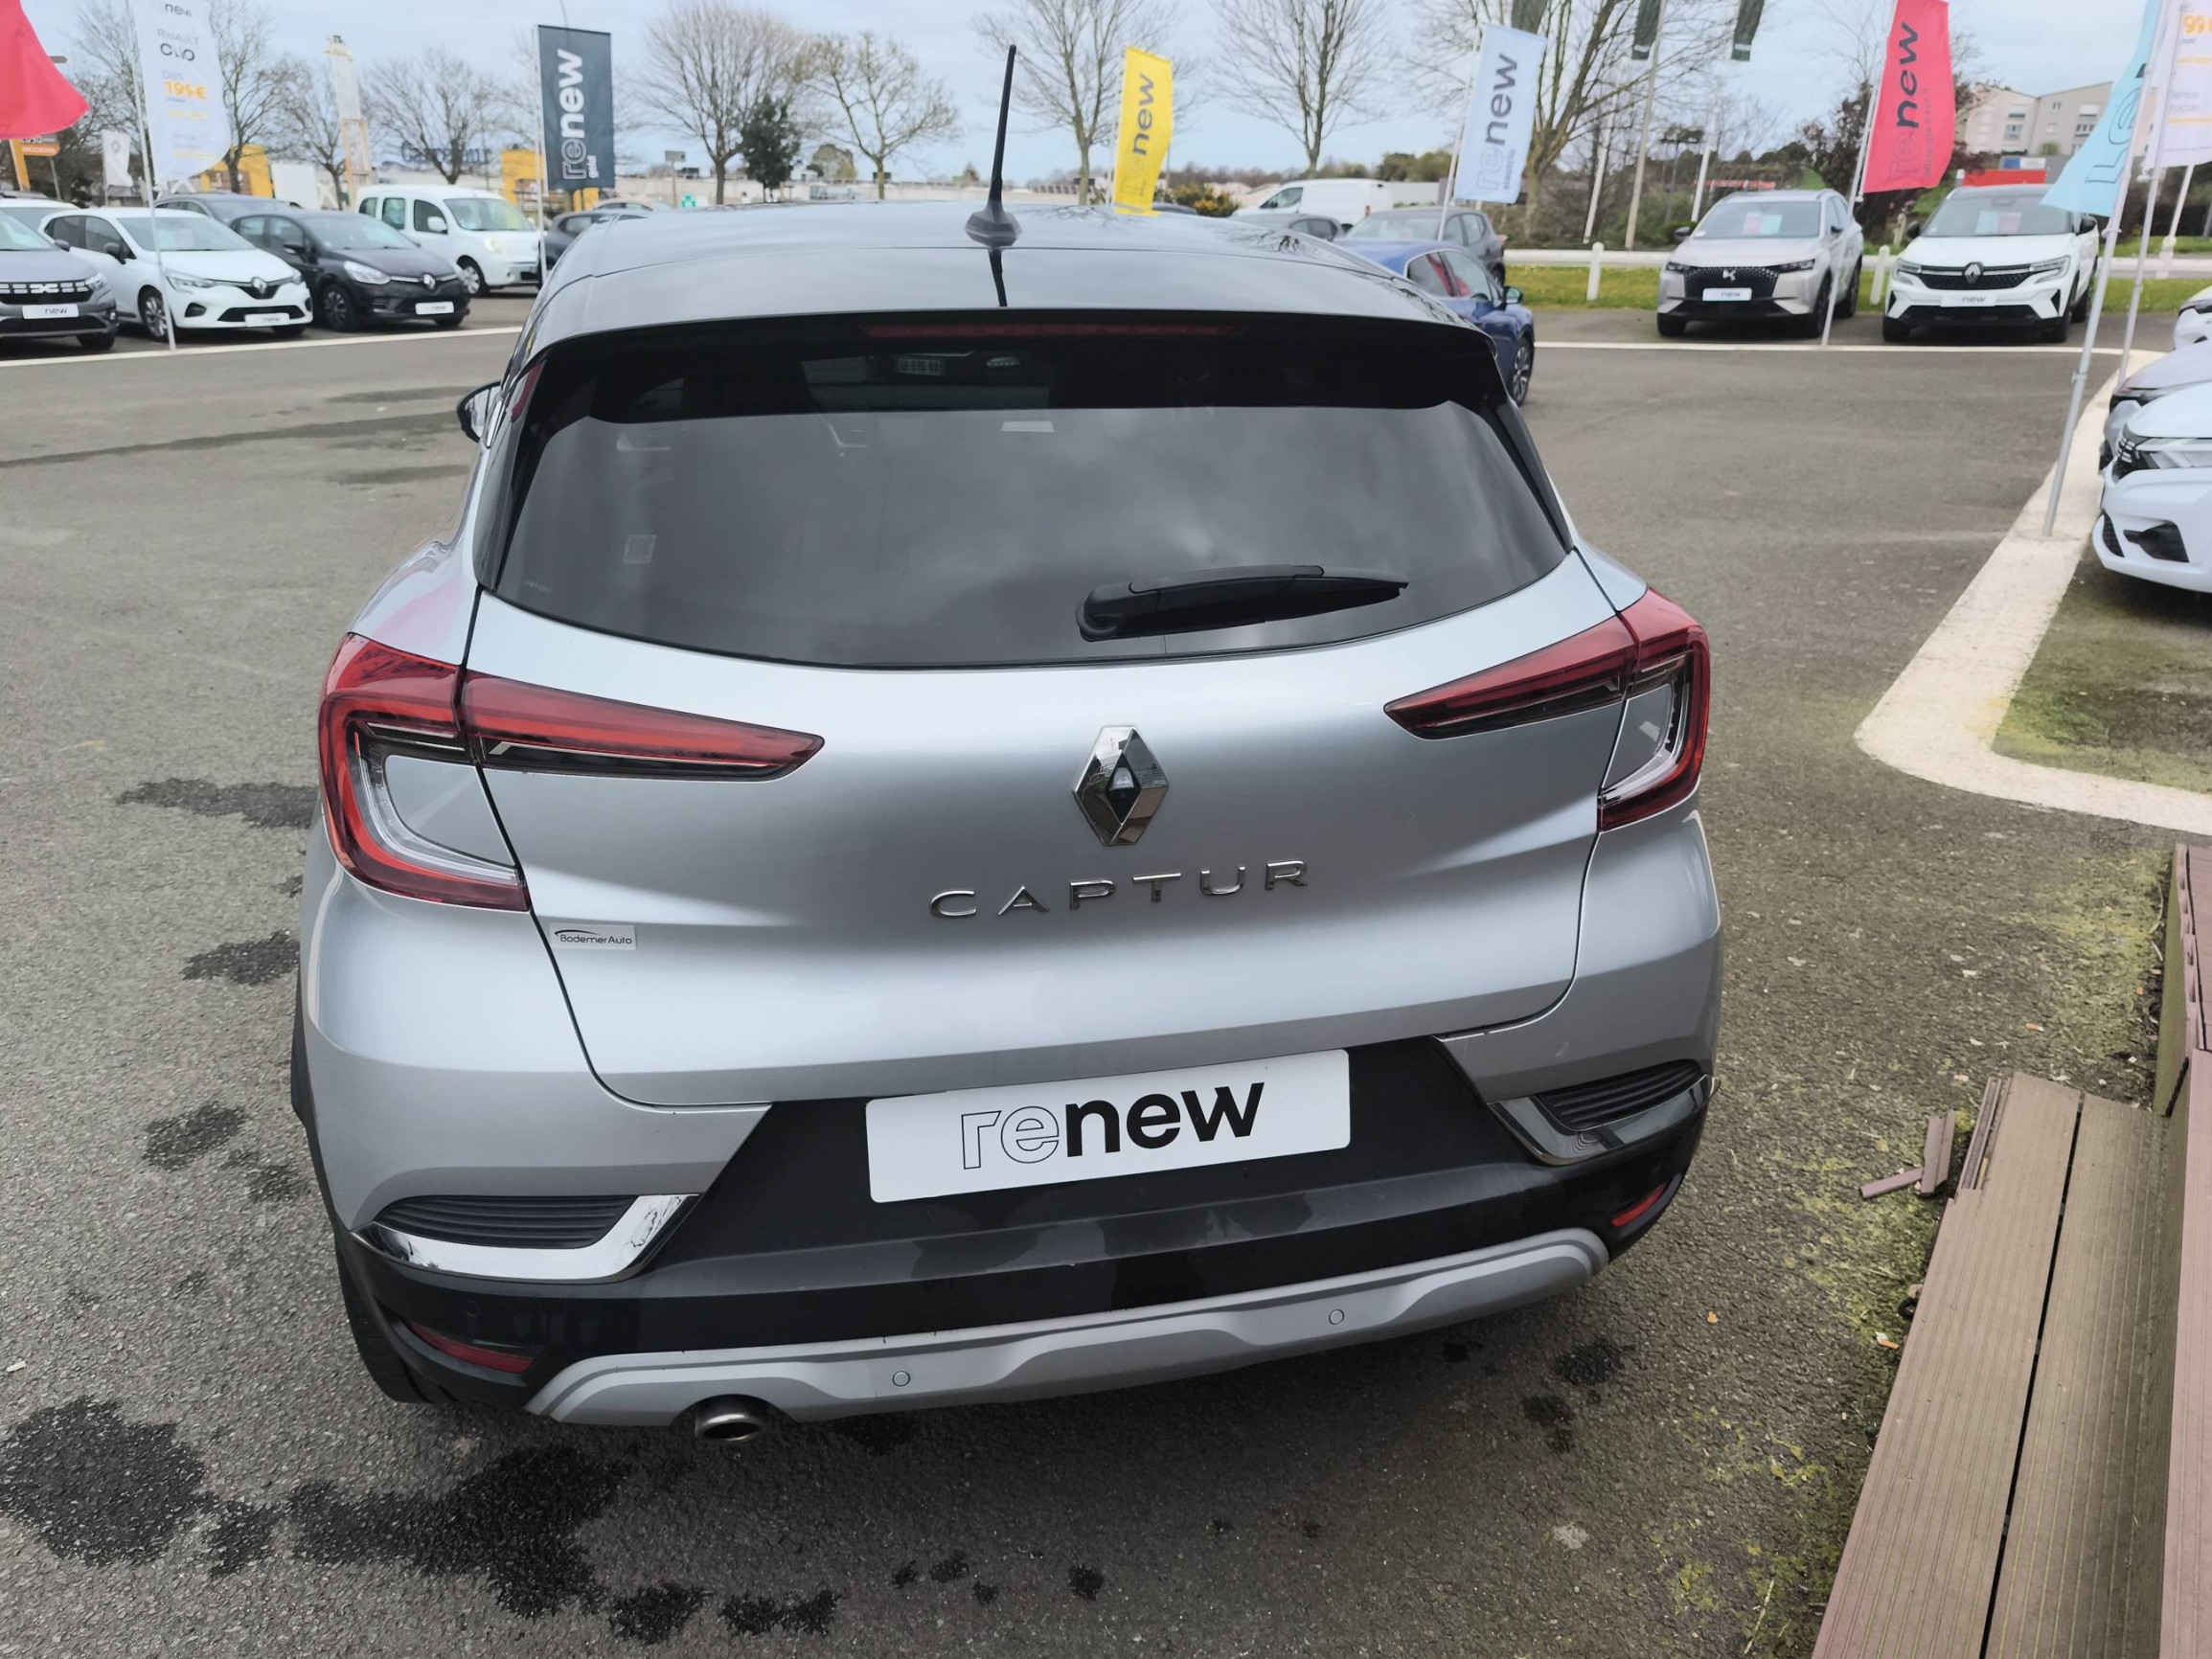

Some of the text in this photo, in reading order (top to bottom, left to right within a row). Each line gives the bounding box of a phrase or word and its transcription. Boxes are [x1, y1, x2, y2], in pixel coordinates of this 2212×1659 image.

[557, 48, 587, 179] renew
[928, 859, 1308, 920] CAPTUR
[961, 1081, 1265, 1170] renew
